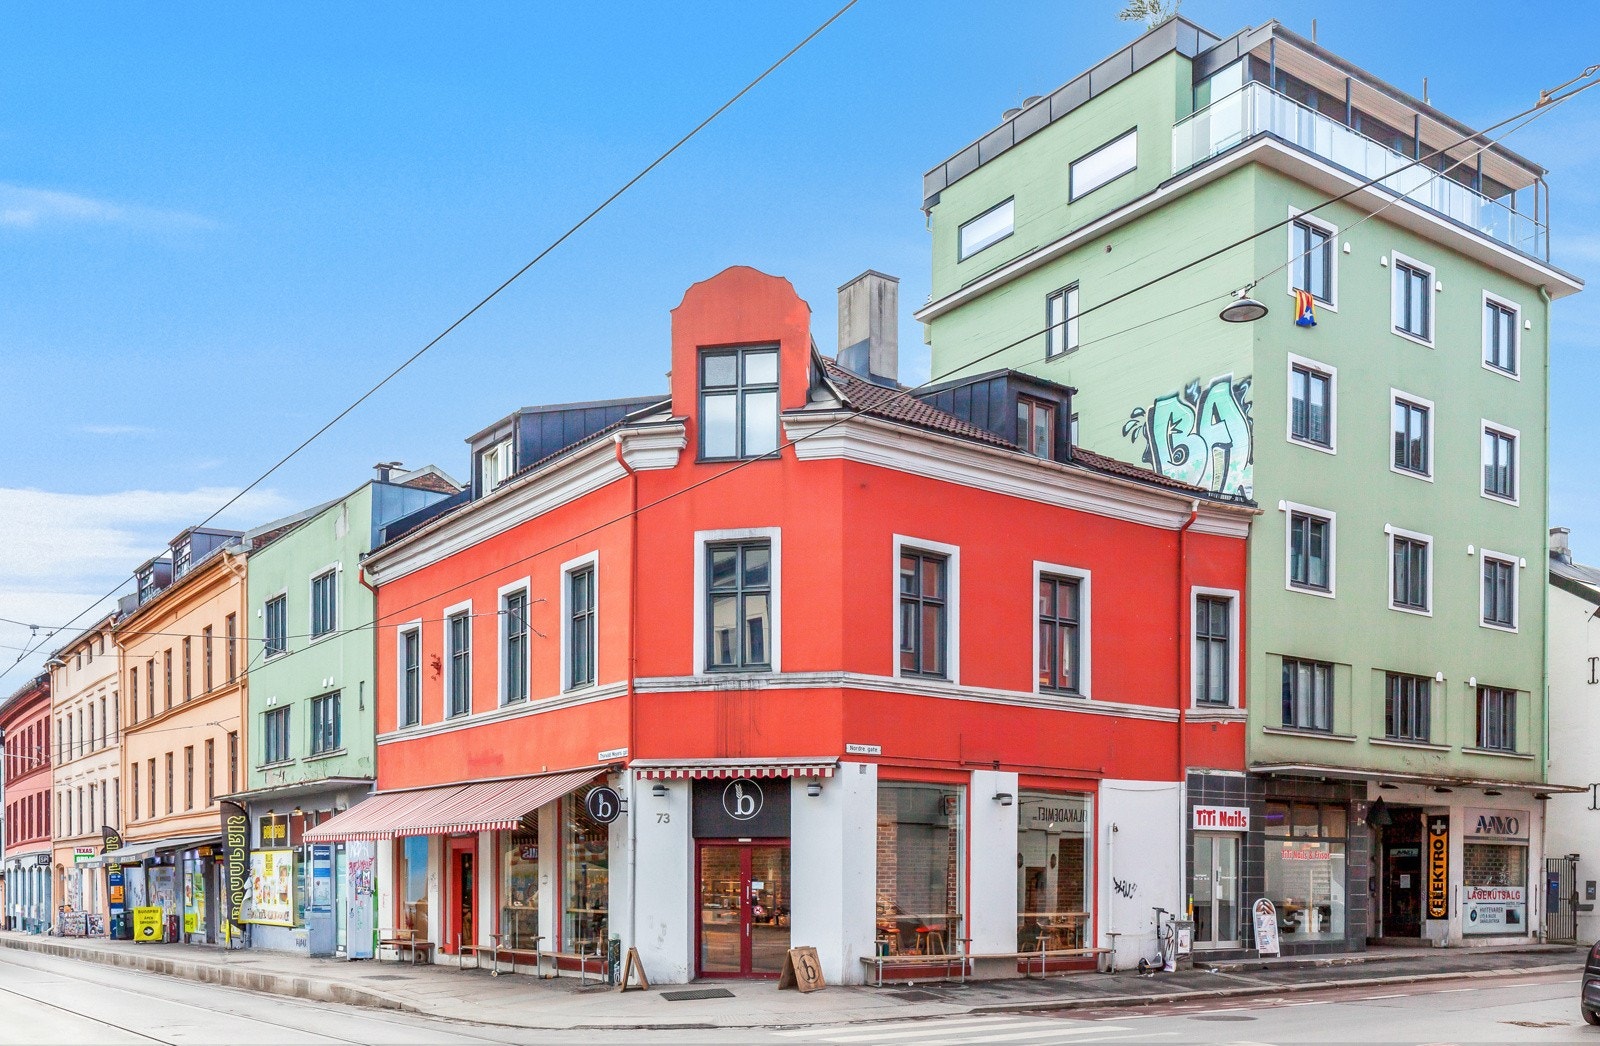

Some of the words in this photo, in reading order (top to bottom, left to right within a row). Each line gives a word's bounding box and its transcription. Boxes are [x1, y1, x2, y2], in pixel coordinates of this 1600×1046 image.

[596, 793, 612, 818] b
[734, 783, 755, 815] b
[656, 813, 670, 823] 73
[1196, 809, 1217, 826] TiTi
[1219, 811, 1247, 827] Nails
[1432, 839, 1444, 909] ELEKTRO
[1467, 890, 1521, 900] LAGERUTSALG
